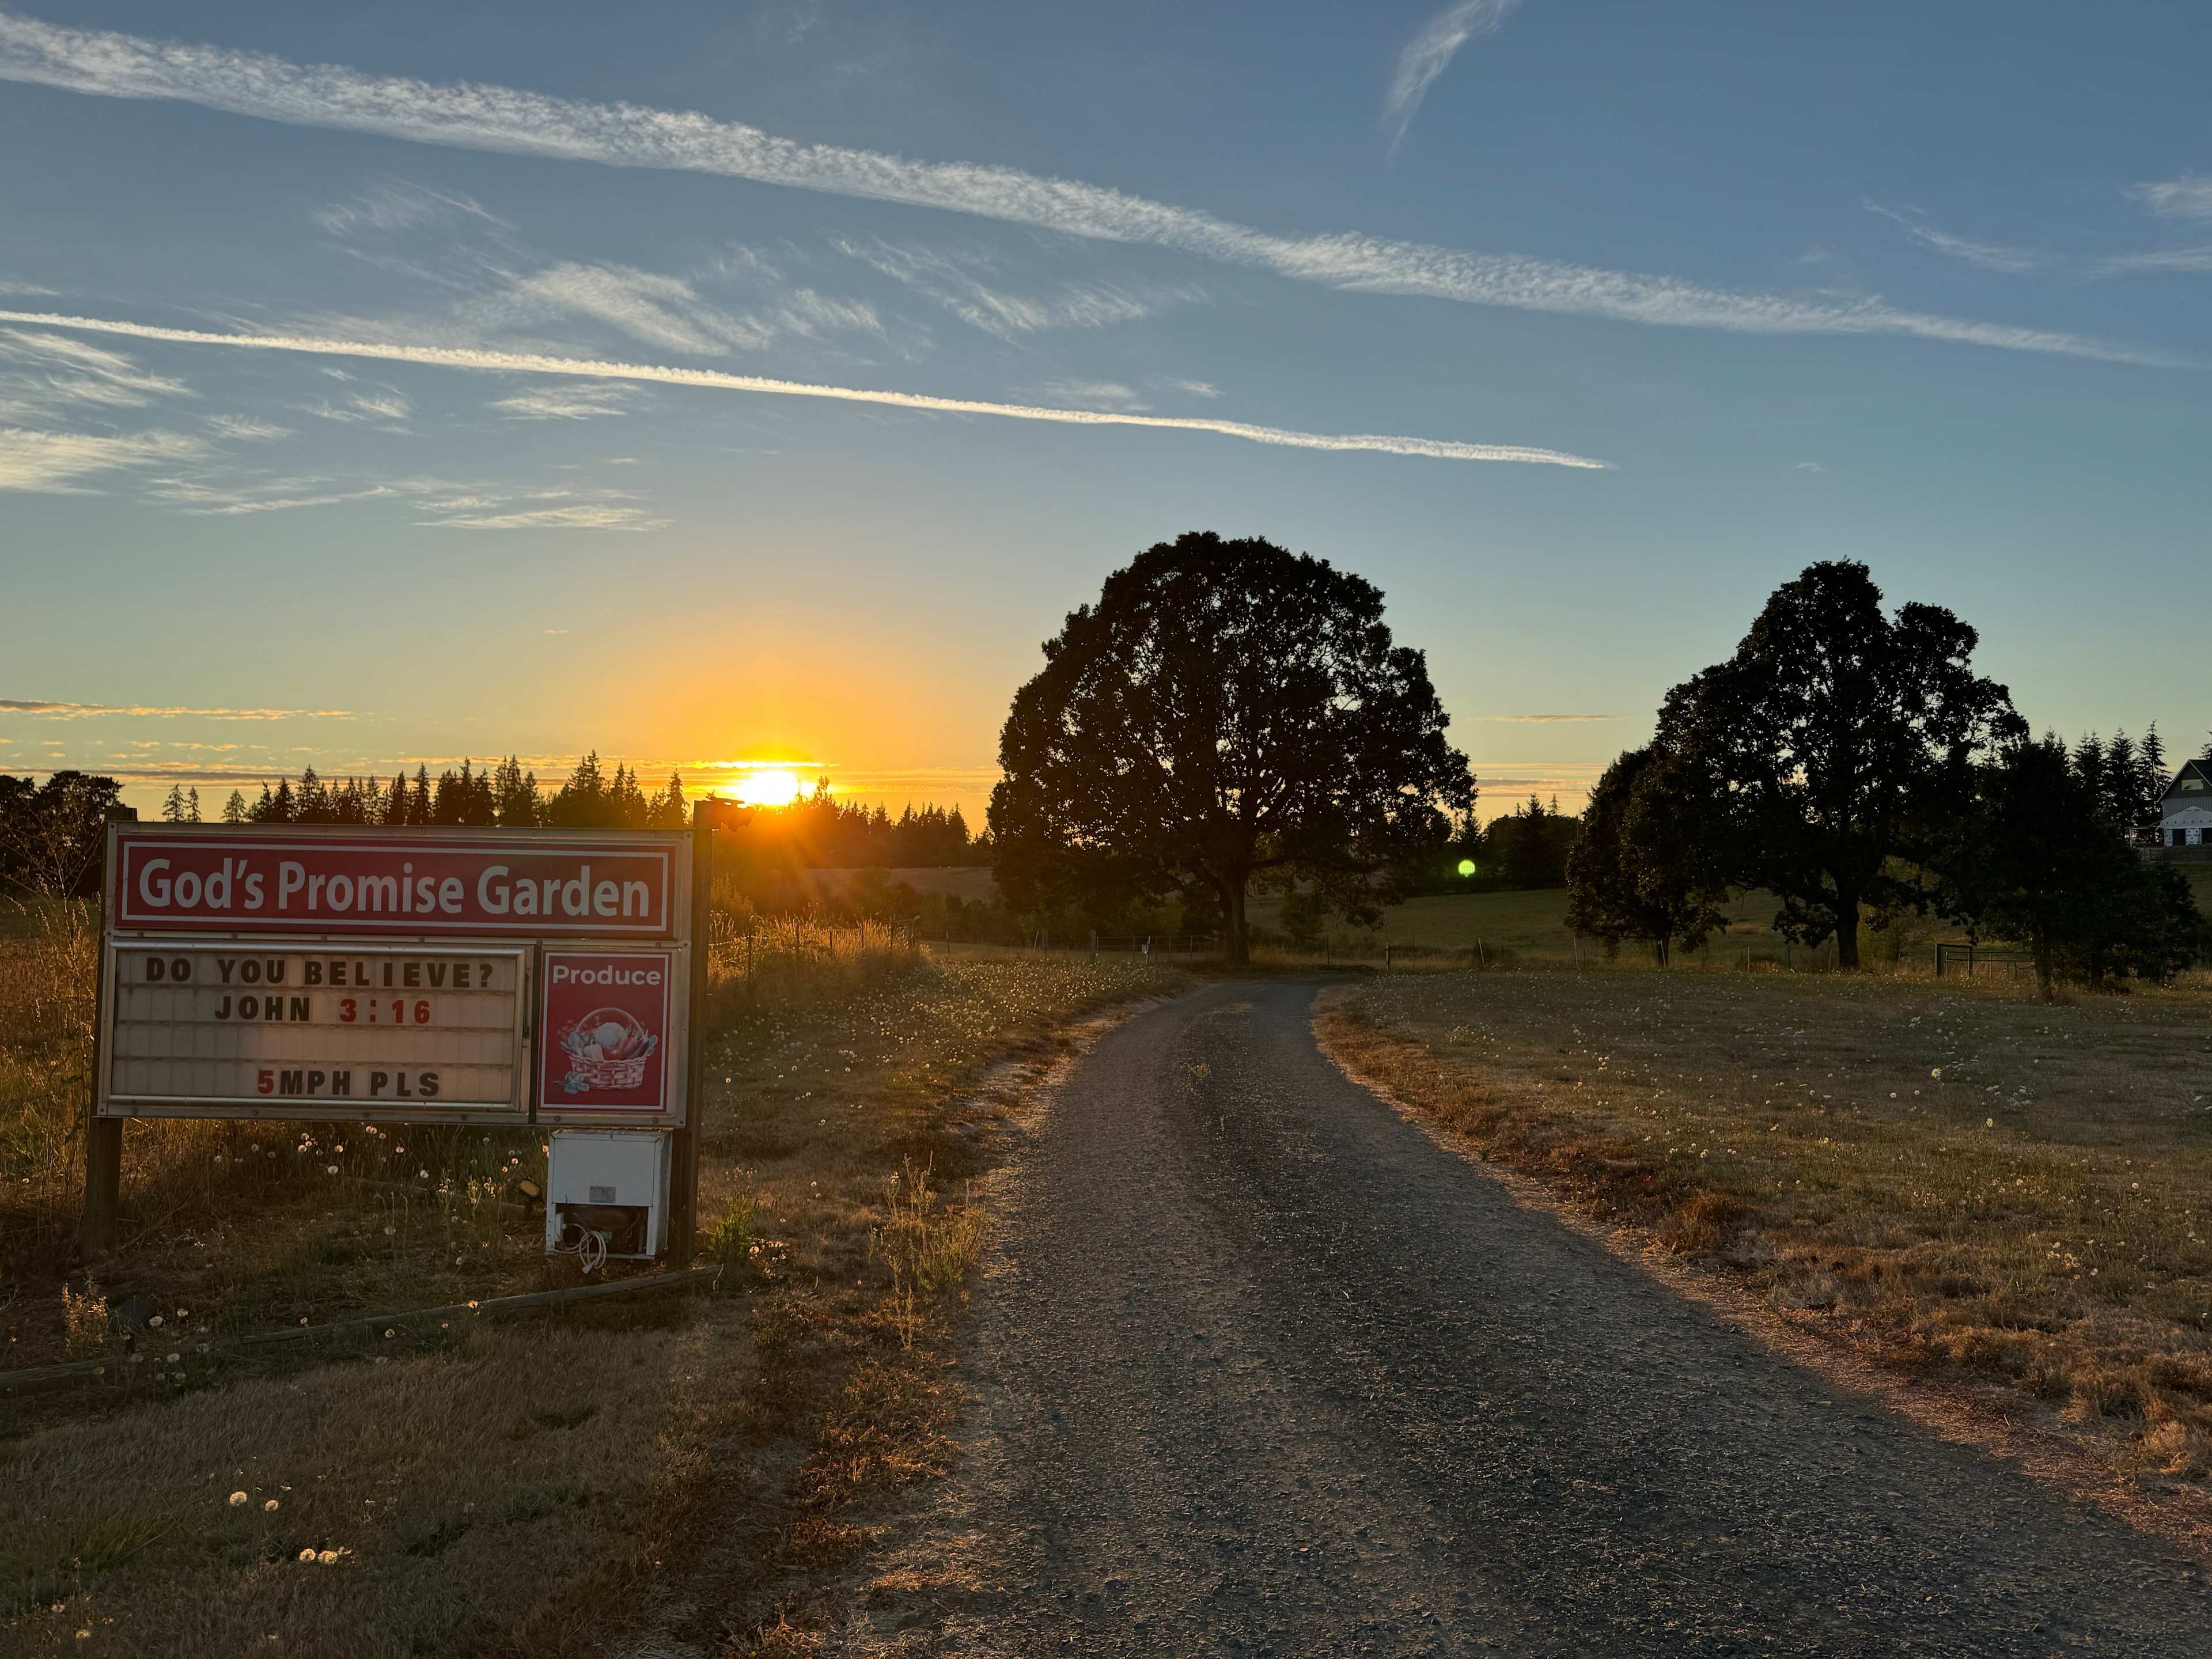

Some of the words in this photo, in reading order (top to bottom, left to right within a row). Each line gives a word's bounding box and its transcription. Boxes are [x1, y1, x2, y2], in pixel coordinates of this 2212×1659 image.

[139, 858, 264, 909] God's
[279, 861, 464, 913] Promise
[477, 865, 649, 917] Garden
[146, 957, 191, 982] DO
[217, 959, 285, 984] YOU
[305, 961, 493, 988] BELIEVE?
[553, 965, 661, 985] Produce
[215, 996, 310, 1022] JOHN
[340, 999, 430, 1024] 3:16
[257, 1070, 351, 1096] 5MPH
[370, 1071, 440, 1097] PLS
